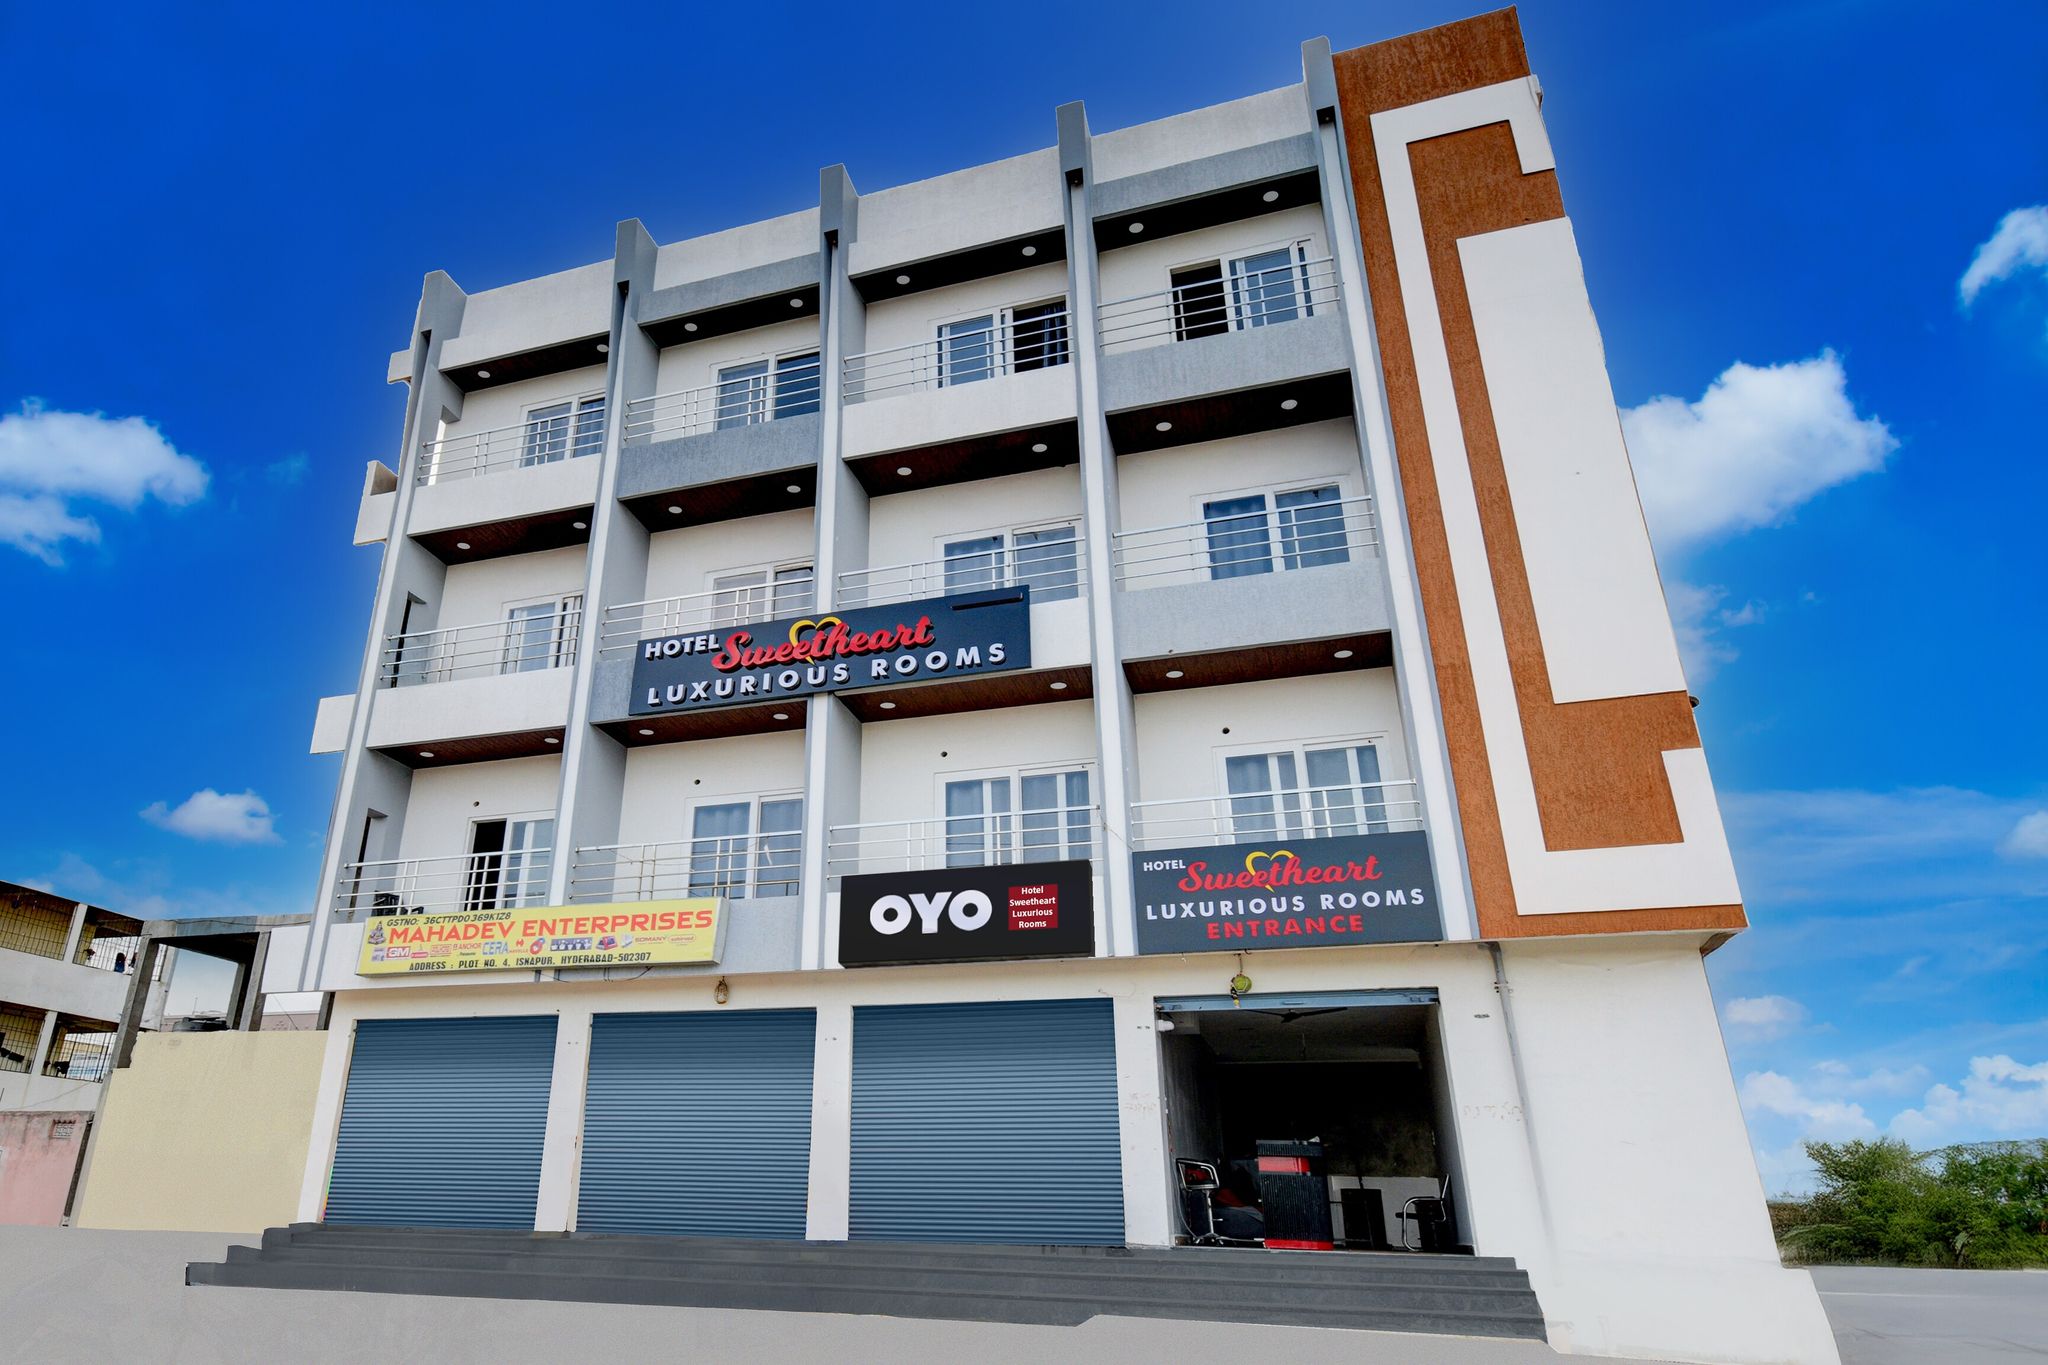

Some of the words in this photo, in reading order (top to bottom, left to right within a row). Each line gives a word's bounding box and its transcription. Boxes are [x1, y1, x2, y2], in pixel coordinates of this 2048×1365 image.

[645, 634, 721, 659] HOTEL
[711, 615, 934, 671] Sweetheart
[647, 662, 850, 706] LUXURIOUS
[871, 642, 1006, 679] ROOMS
[1143, 859, 1186, 872] HOTEL
[1178, 854, 1383, 893] Sweetheart
[1009, 896, 1056, 907] Sweetheart
[1021, 885, 1044, 895] Hotel
[870, 889, 993, 935] OYO
[1012, 909, 1053, 918] Luxurious
[1146, 896, 1305, 920] LUXURIOUS
[1320, 888, 1425, 910] ROOMS
[389, 921, 516, 944] MAHADEV
[522, 910, 713, 937] ENTERPRISES
[1018, 920, 1047, 929] Rooms
[1207, 914, 1364, 940] ENTRANCE
[482, 941, 508, 955] CERA
[409, 961, 447, 971] ADDRESS
[458, 959, 479, 968] PLOT
